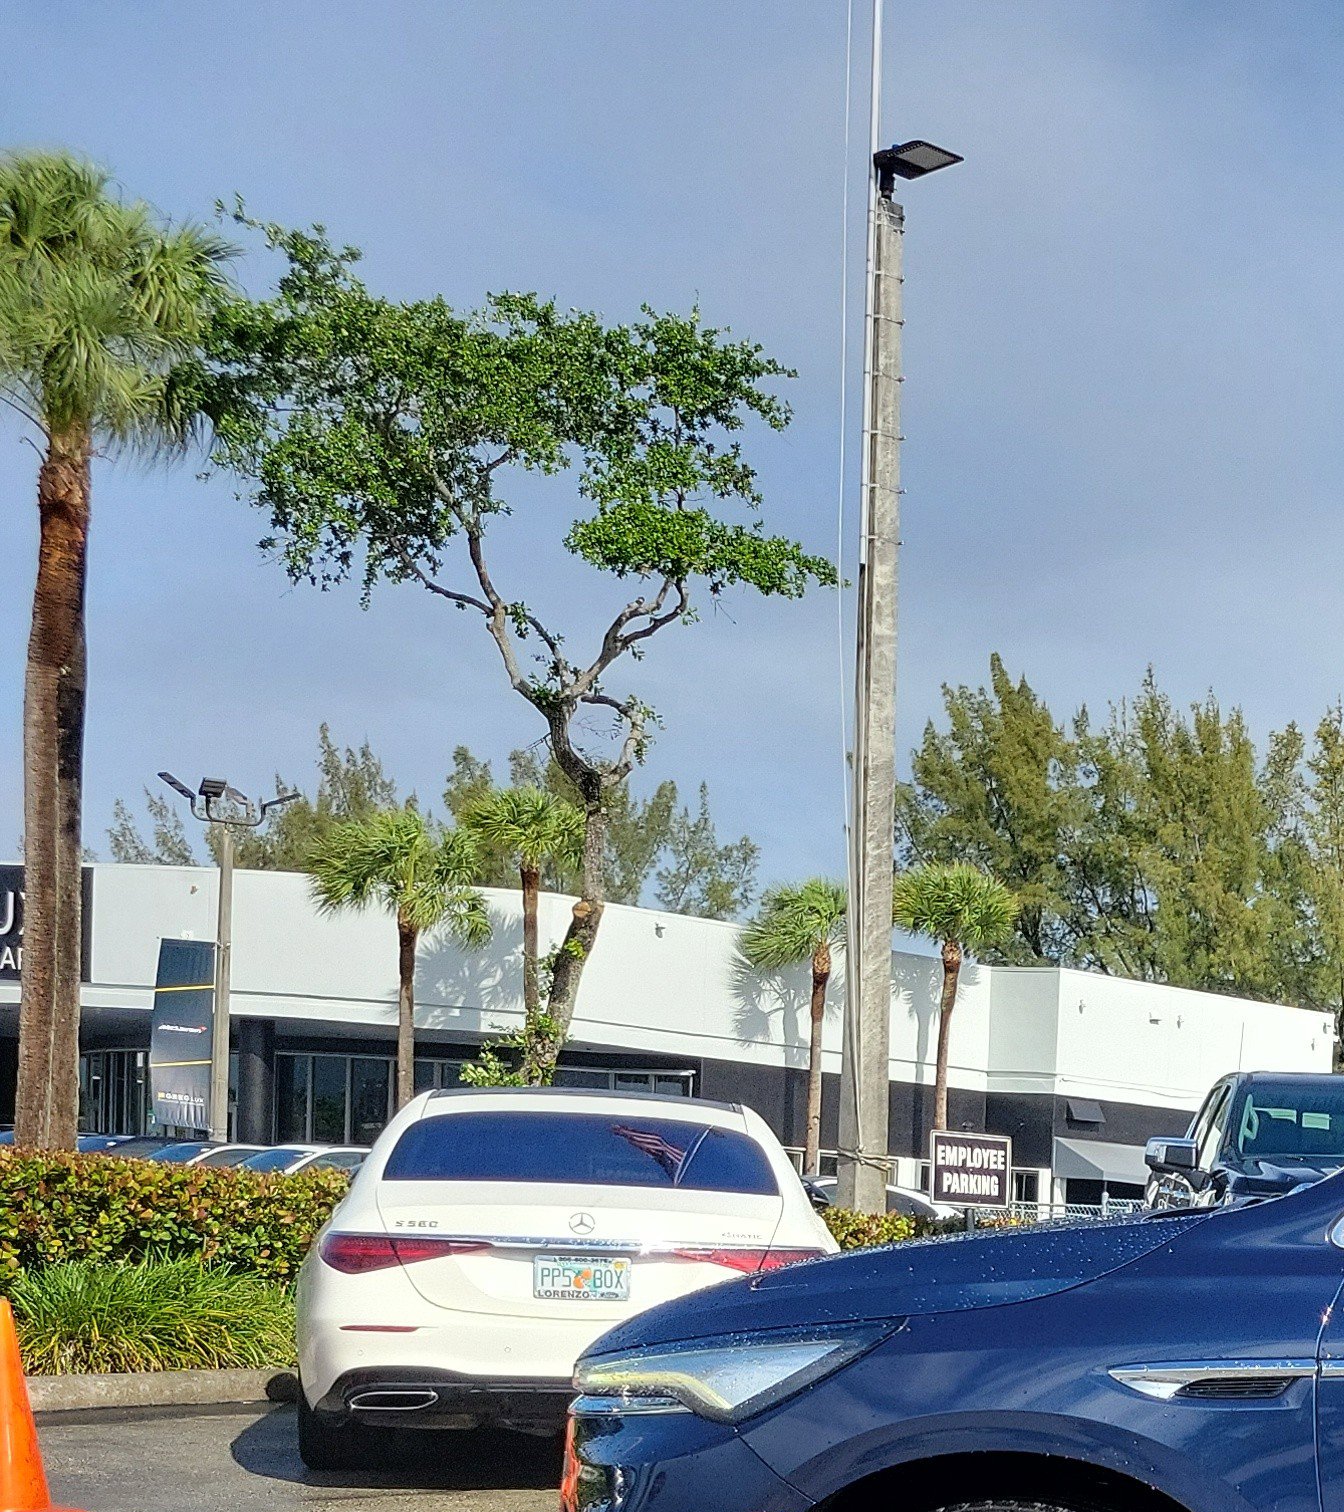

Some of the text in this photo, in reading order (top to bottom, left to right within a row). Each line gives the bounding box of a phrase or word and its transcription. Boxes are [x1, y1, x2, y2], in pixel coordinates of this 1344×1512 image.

[936, 1144, 1006, 1171] EMPLOYEE
[942, 1171, 999, 1197] PARKING
[538, 1289, 590, 1299] LORENZO
